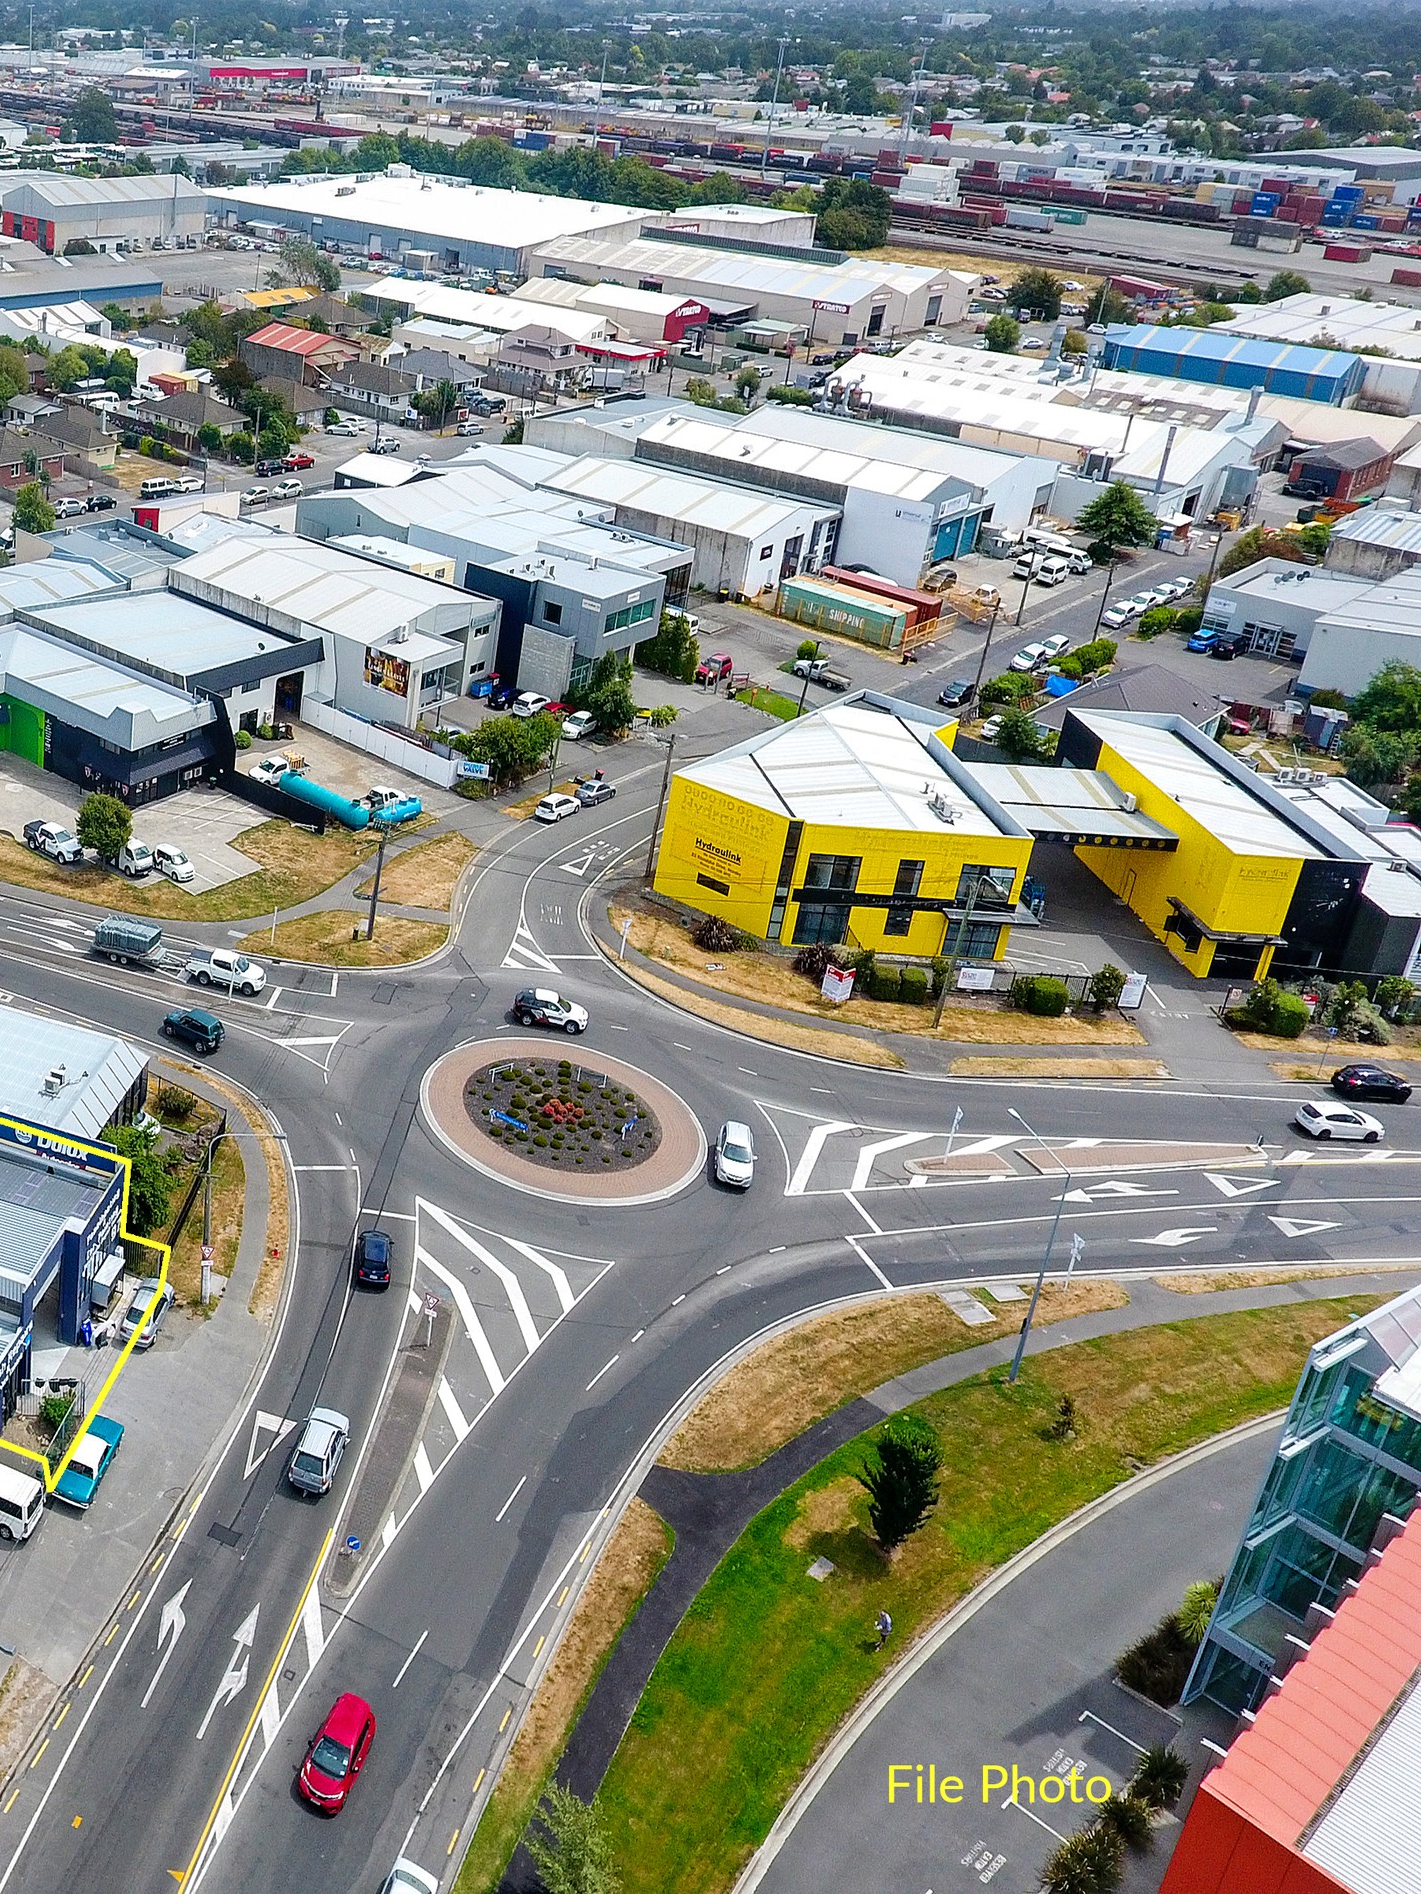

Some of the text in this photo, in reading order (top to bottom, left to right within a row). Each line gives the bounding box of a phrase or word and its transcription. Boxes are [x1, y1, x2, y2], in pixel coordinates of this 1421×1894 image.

[695, 837, 742, 863] Hydraulink
[974, 1850, 993, 1872] EATON
[979, 1853, 1007, 1884] RESERVED
